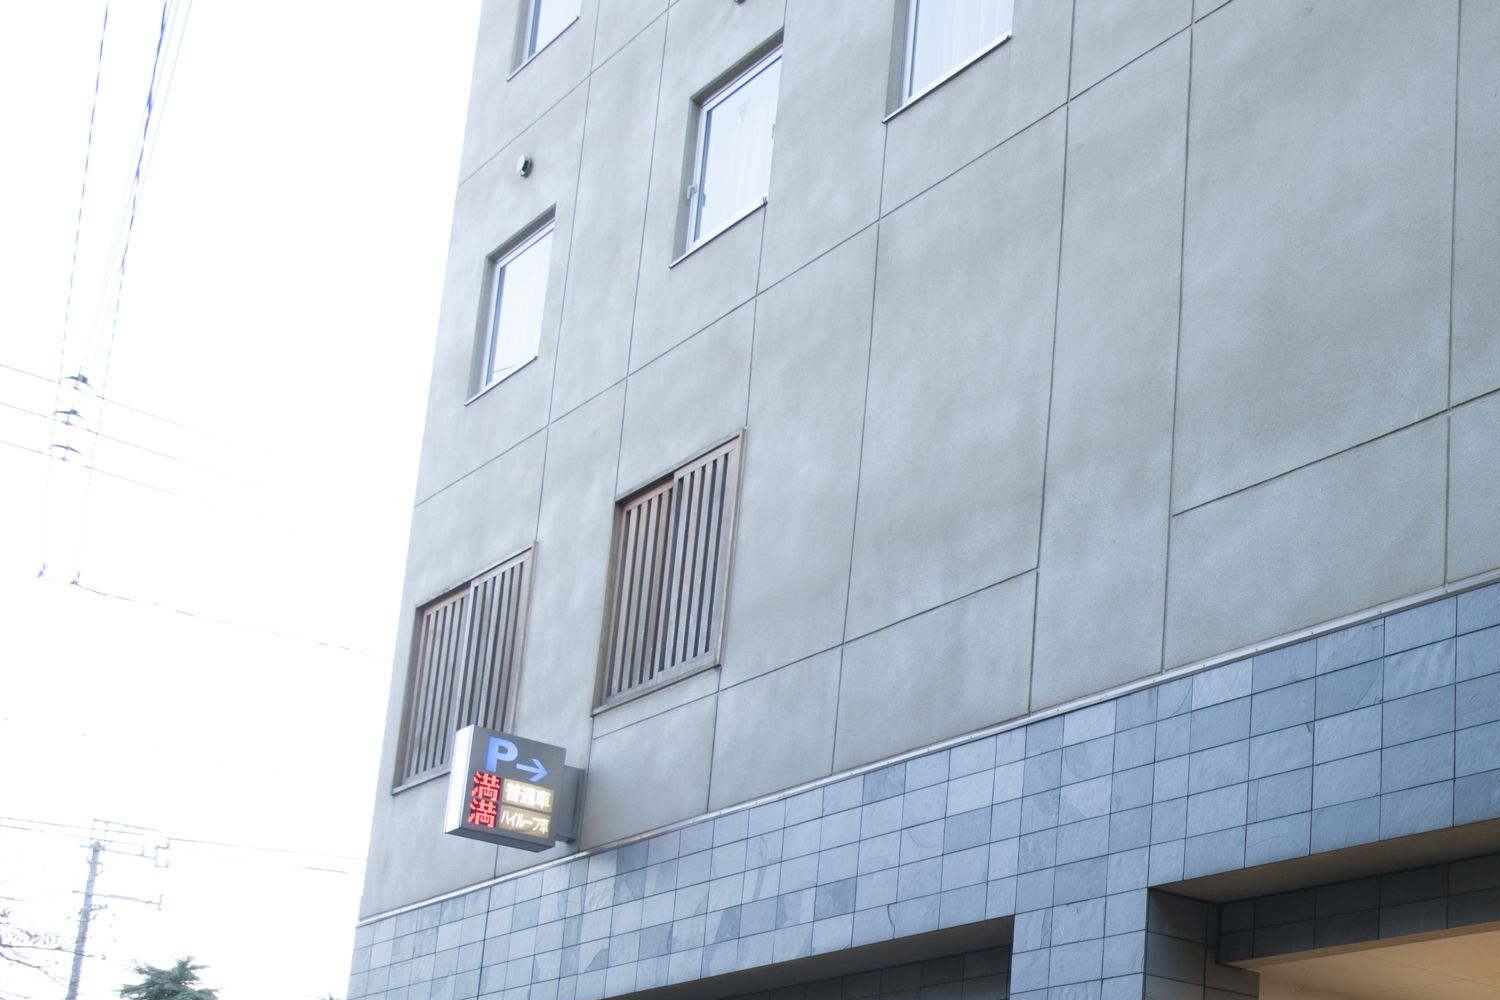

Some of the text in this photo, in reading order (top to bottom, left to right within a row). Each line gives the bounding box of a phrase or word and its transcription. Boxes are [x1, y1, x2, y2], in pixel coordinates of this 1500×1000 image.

[485, 735, 518, 773] P
[473, 770, 551, 809] 満 普通車
[467, 798, 549, 834] 満 ハイルーフ車
